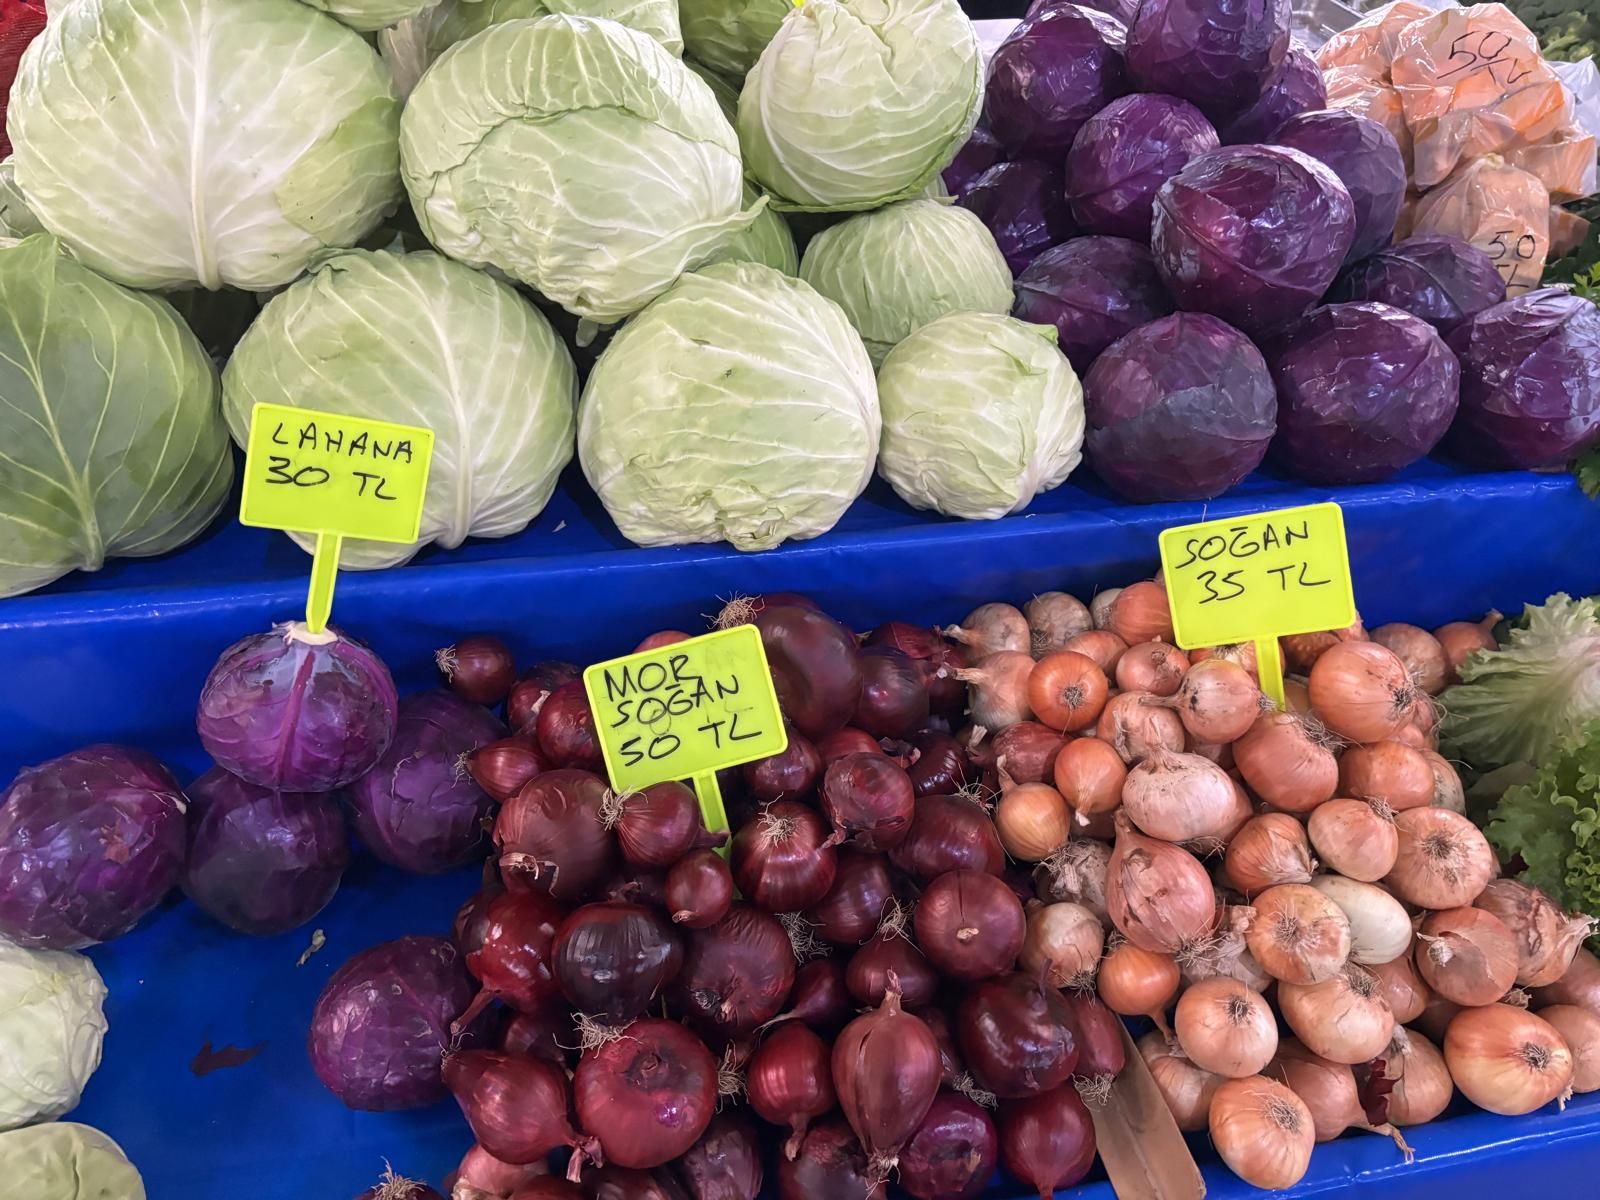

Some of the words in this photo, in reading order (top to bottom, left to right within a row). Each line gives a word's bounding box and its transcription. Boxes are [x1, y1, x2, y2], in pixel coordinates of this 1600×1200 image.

[1436, 31, 1512, 79] 50
[1470, 58, 1532, 84] TL
[1488, 230, 1536, 260] 50
[272, 422, 412, 463] LAHANA
[265, 455, 330, 487] 30
[352, 471, 397, 501] TL
[1197, 570, 1245, 604] 35
[1267, 562, 1331, 590] TL
[604, 654, 701, 702] MOR
[620, 734, 681, 767] 50
[698, 713, 762, 749] TL
